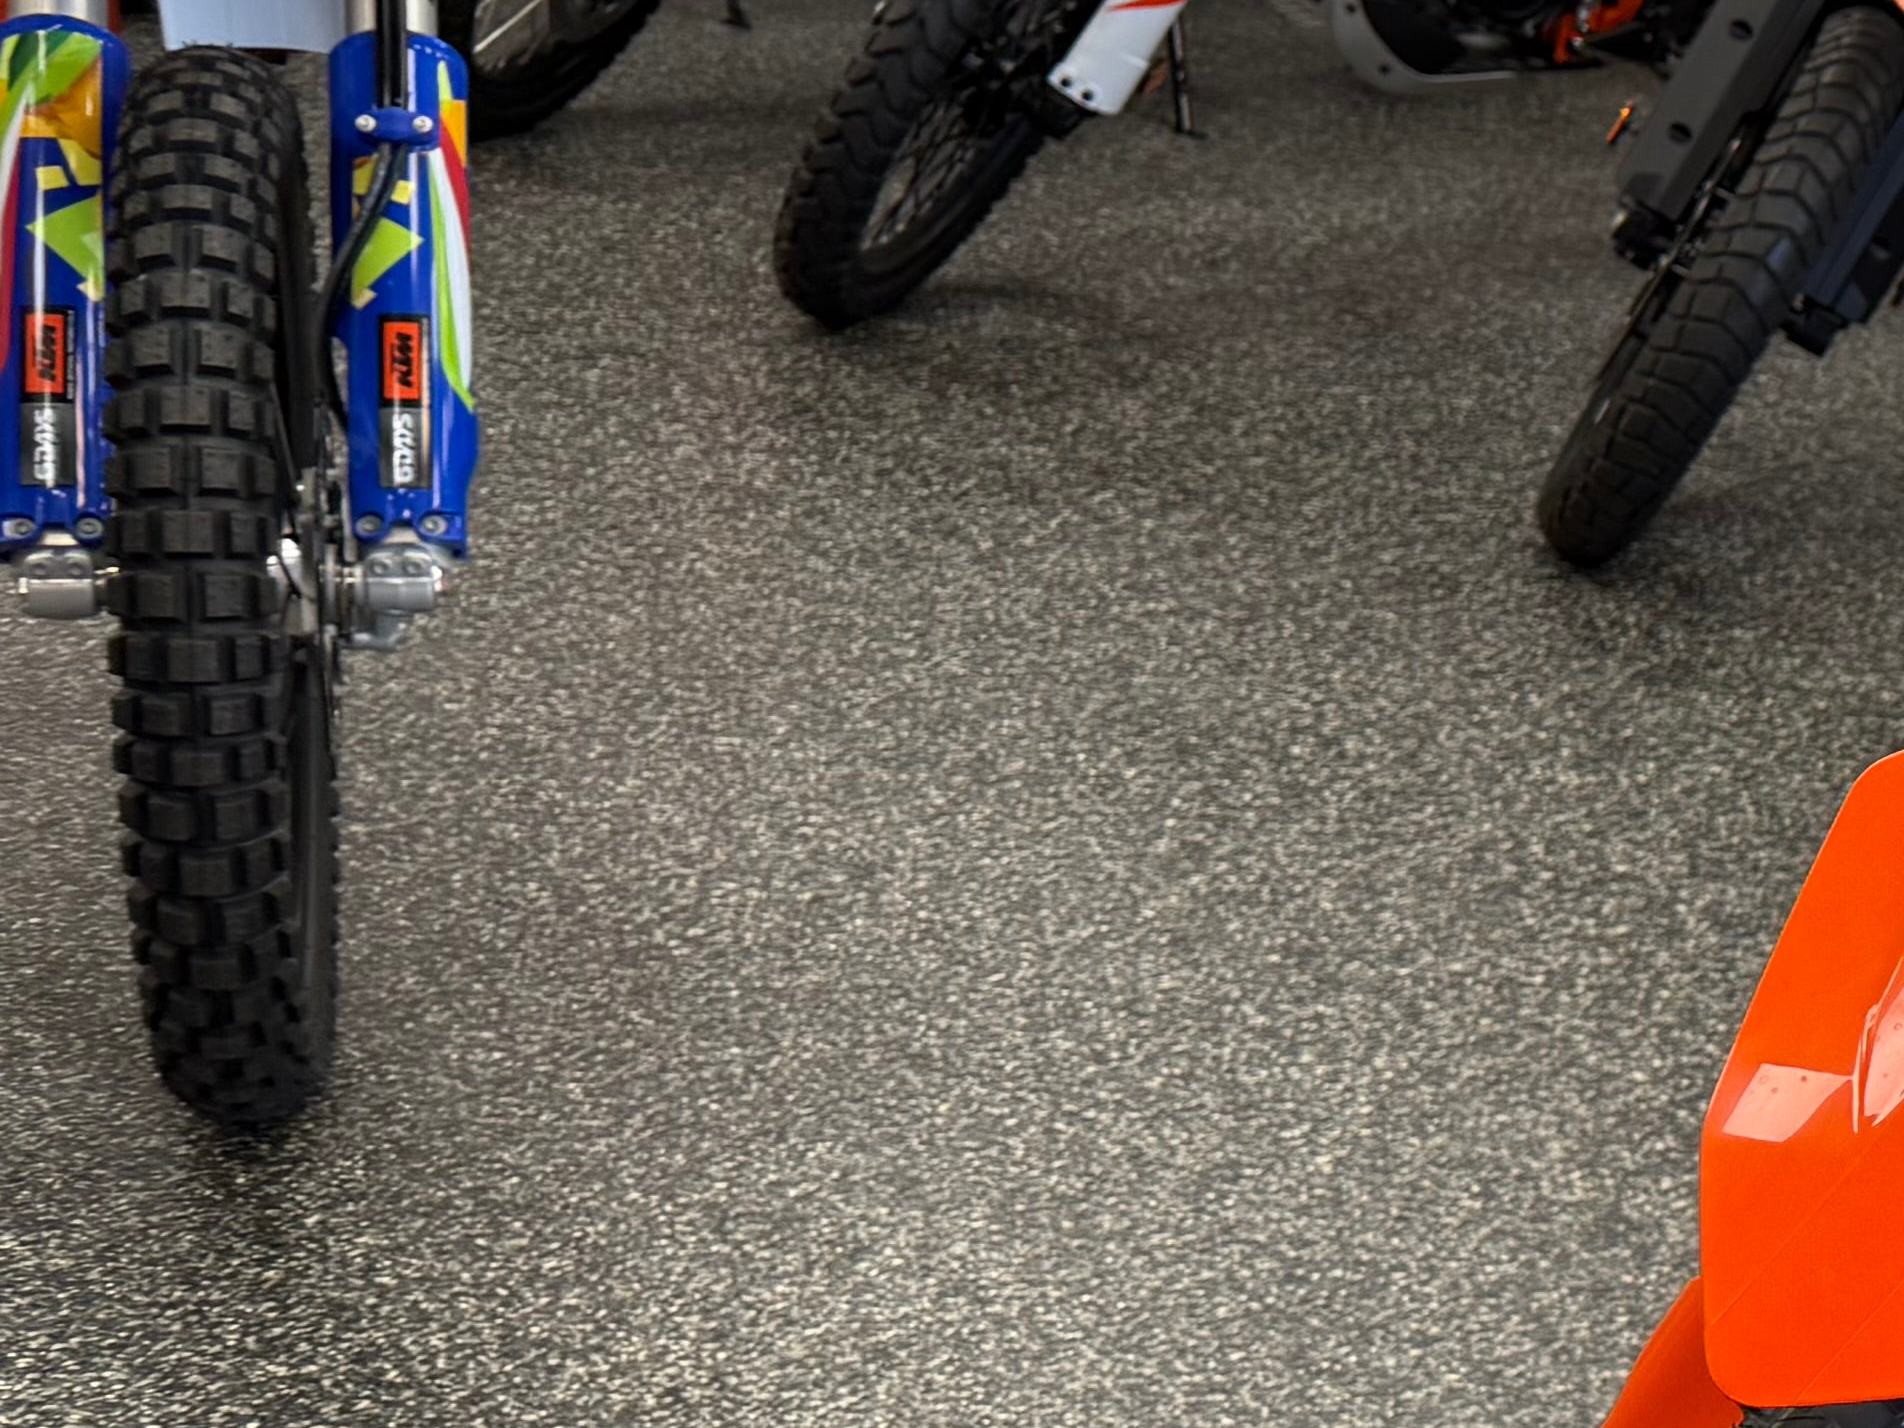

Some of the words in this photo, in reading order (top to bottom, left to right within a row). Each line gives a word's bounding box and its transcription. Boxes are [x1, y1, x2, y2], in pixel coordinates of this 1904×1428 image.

[33, 324, 57, 384] KTM
[391, 331, 414, 389] KTM
[33, 407, 57, 482] 6DAYS
[392, 412, 416, 484] 6DAYS
